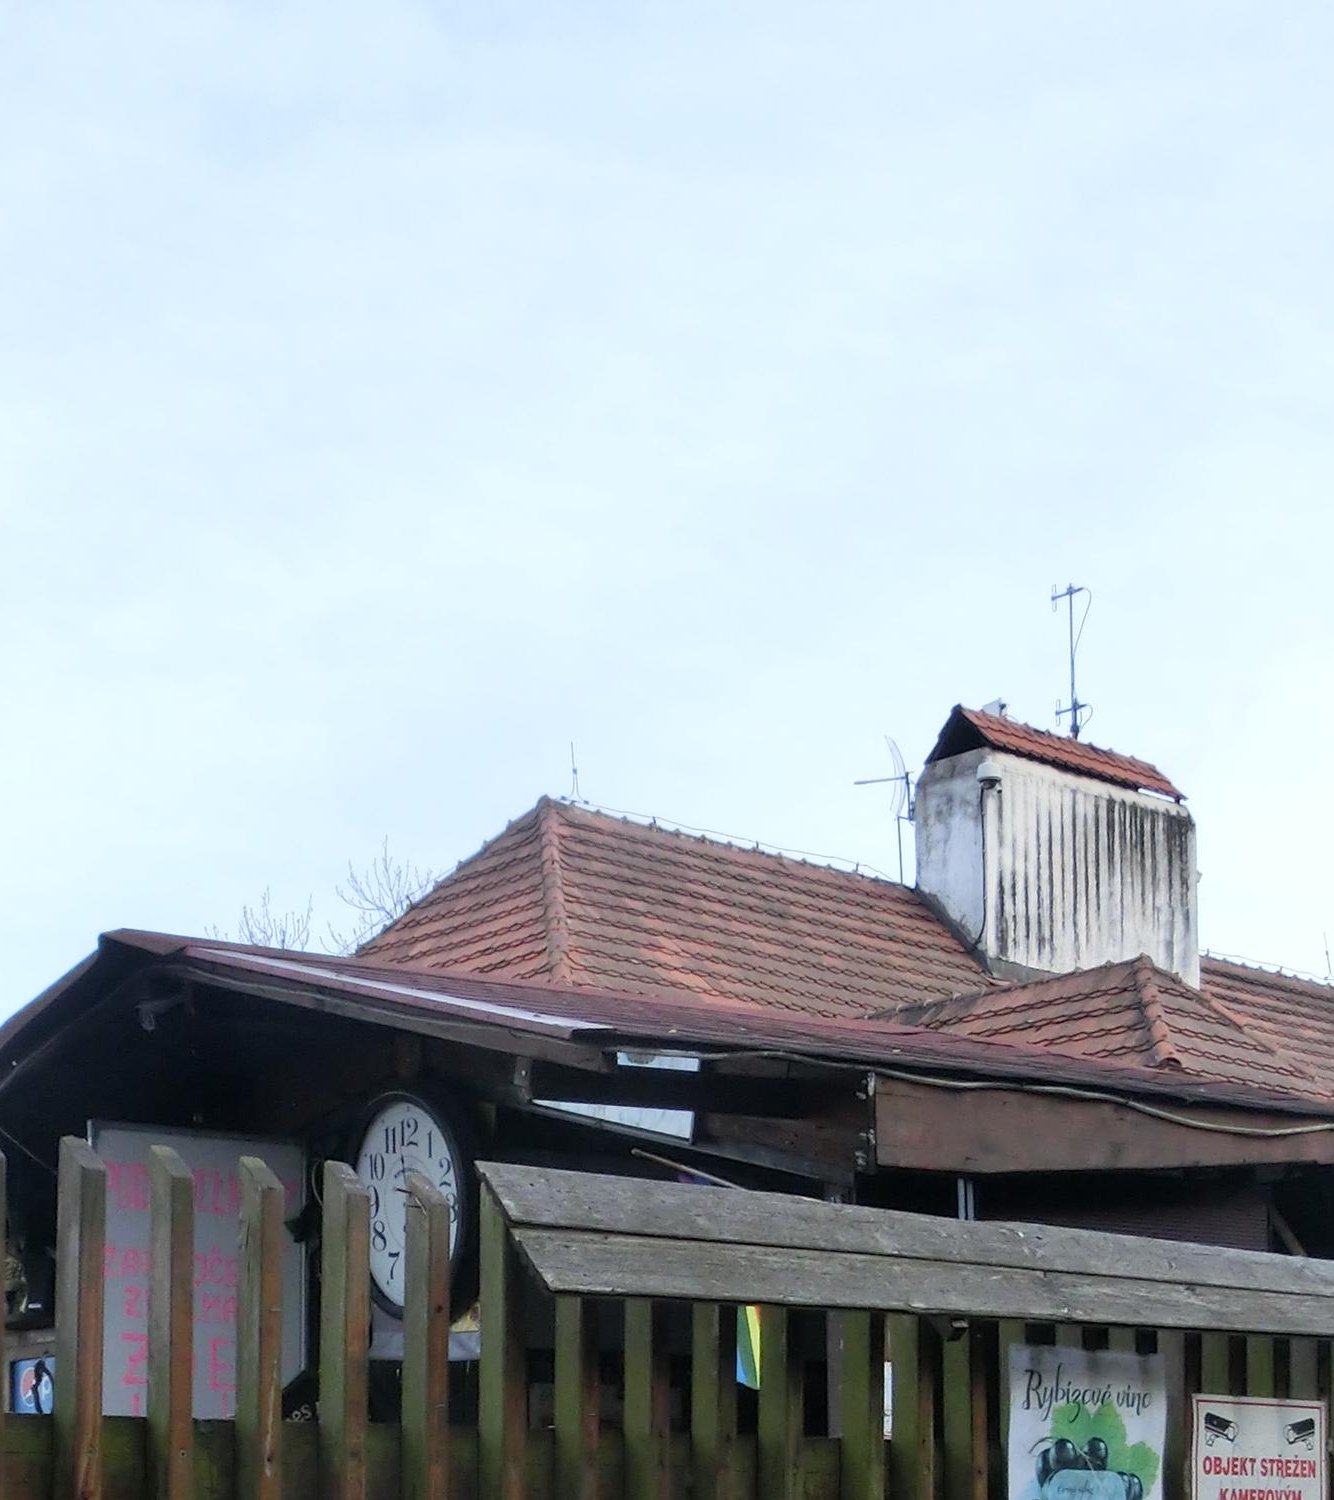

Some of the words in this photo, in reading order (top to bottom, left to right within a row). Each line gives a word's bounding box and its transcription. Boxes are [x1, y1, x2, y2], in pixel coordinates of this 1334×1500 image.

[384, 1126, 397, 1154] 11
[400, 1117, 419, 1147] 12
[427, 1130, 433, 1158] 1
[369, 1152, 385, 1181] 10
[439, 1157, 451, 1187] 2
[372, 1220, 387, 1251] 8
[388, 1252, 400, 1280] 7
[1203, 1456, 1257, 1476] OBJEKT
[1260, 1454, 1317, 1478] STŘEŽEN
